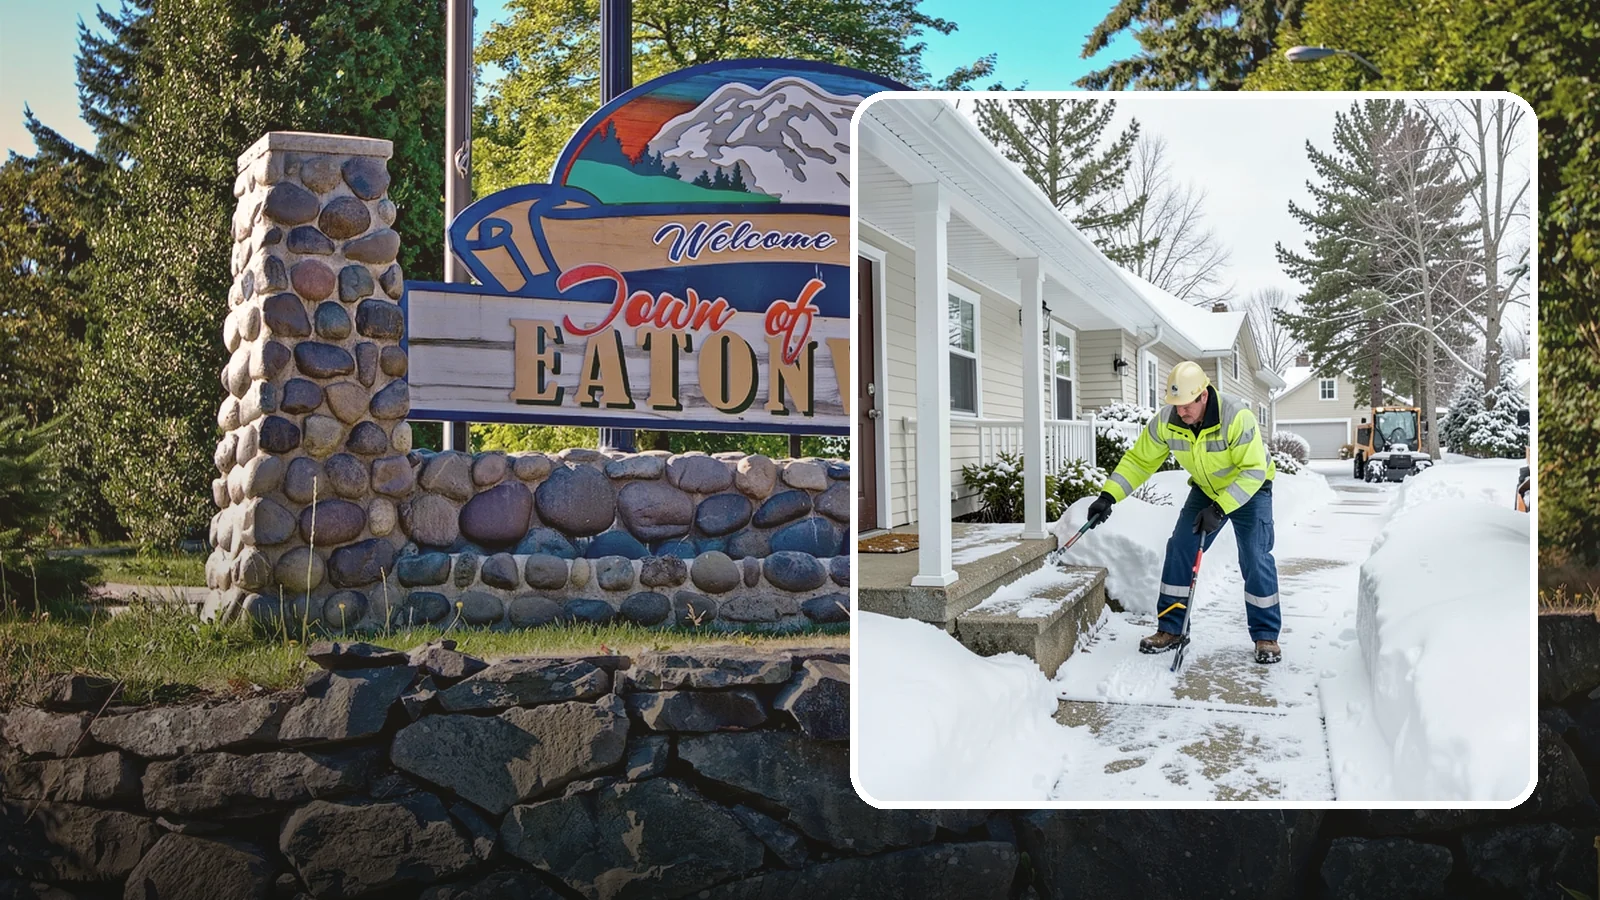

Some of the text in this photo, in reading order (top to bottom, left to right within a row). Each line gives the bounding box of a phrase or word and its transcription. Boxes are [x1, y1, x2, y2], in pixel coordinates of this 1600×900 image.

[654, 221, 836, 262] Welcome
[556, 264, 826, 365] Town of
